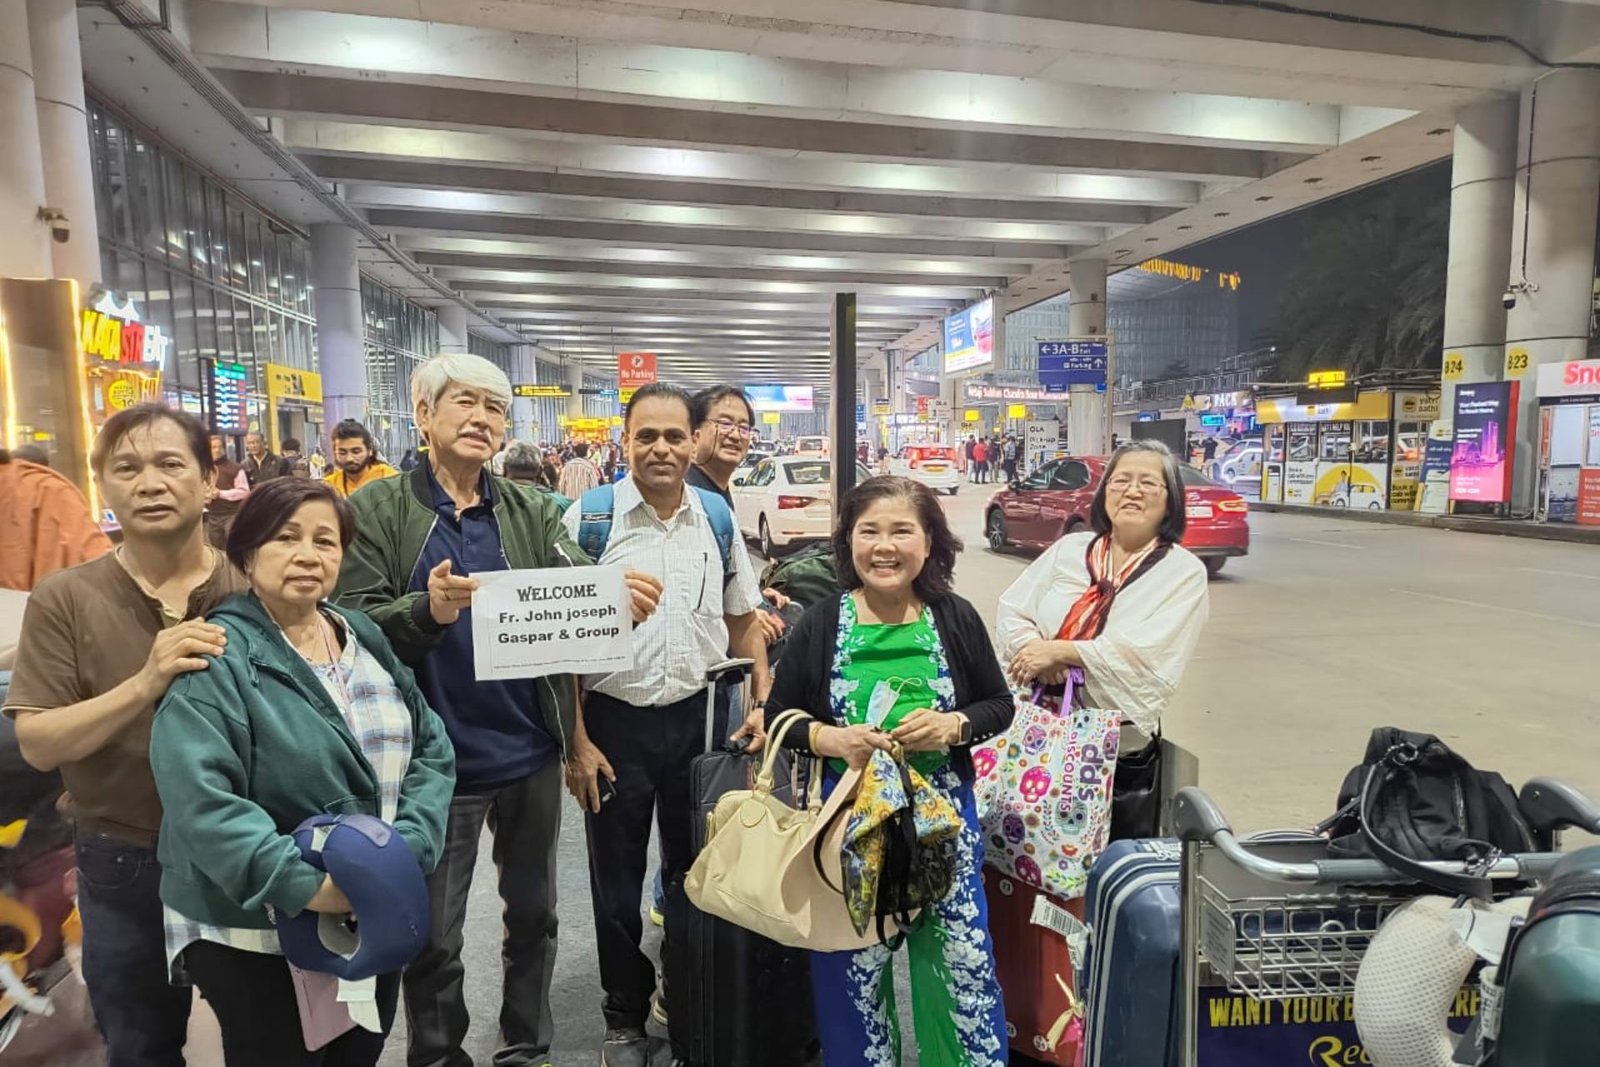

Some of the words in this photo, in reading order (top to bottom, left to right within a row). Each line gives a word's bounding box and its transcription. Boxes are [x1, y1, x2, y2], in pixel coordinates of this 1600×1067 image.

[1052, 344, 1079, 354] 3A-B
[631, 369, 655, 381] Parking
[516, 584, 597, 602] WELCOME
[499, 612, 520, 623] Fr.
[525, 608, 562, 623] John
[567, 604, 617, 622] joseph
[498, 630, 553, 644] Gaspar
[559, 629, 570, 639] &
[575, 625, 620, 639] Group
[1060, 731, 1078, 812] DISCOUNTS
[1209, 996, 1271, 1027] WANT
[1281, 995, 1340, 1024] YOUR
